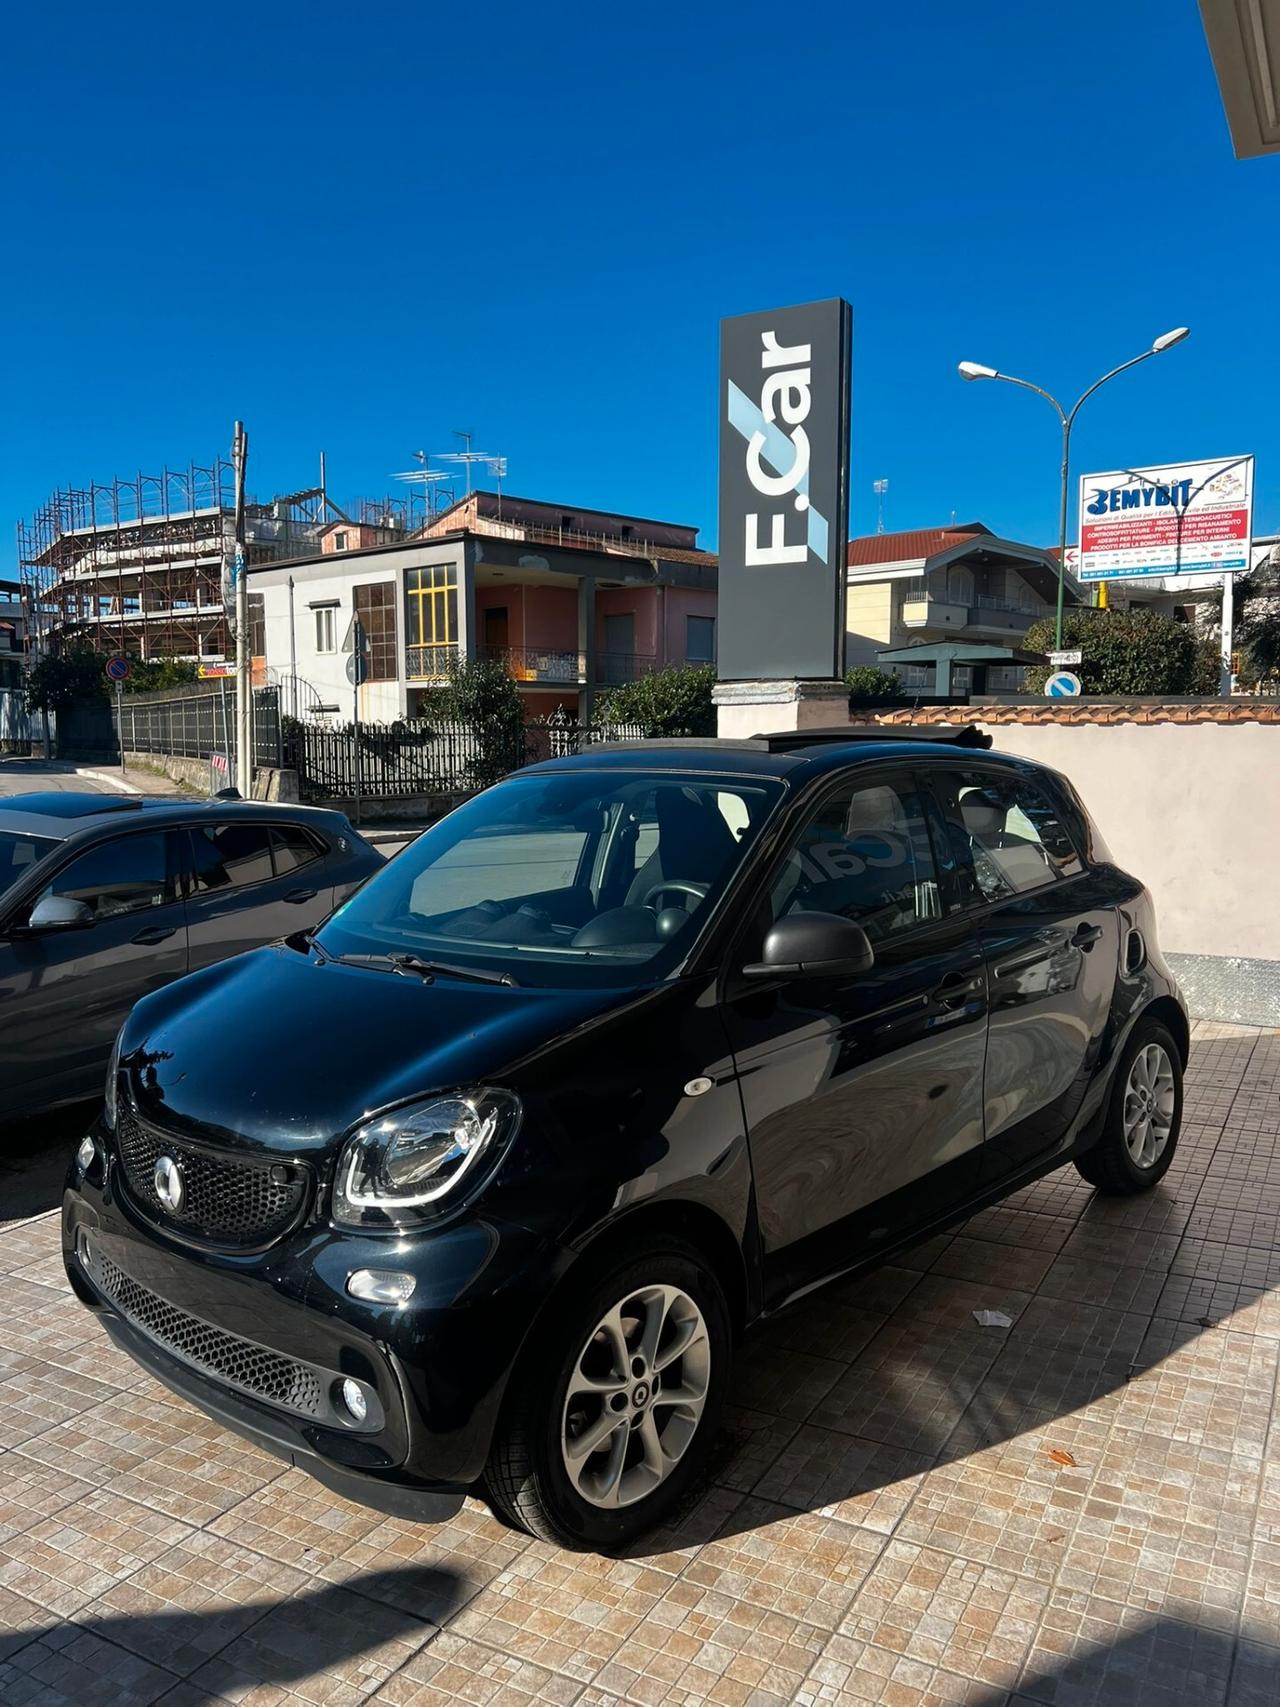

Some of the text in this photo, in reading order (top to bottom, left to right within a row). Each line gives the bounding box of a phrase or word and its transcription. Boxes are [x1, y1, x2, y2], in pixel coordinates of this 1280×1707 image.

[745, 331, 811, 566] F.Car
[1087, 527, 1150, 539] CONTROSOFFITTATURE
[1185, 522, 1196, 530] PER
[1198, 518, 1241, 528] RISANAMENTO
[1094, 520, 1152, 531] IMPERMEABILIZZANTI
[1184, 513, 1232, 523] TERMOACUSTICI
[1090, 543, 1118, 551] PRODOTTI
[1140, 539, 1166, 547] BONIFICA
[1180, 535, 1208, 543] CEMENTO
[1210, 532, 1237, 541] AMIANTO
[1097, 536, 1119, 544] ADESIVI
[1132, 533, 1161, 541] PAVIMENTI
[1206, 526, 1229, 534] INTERNI
